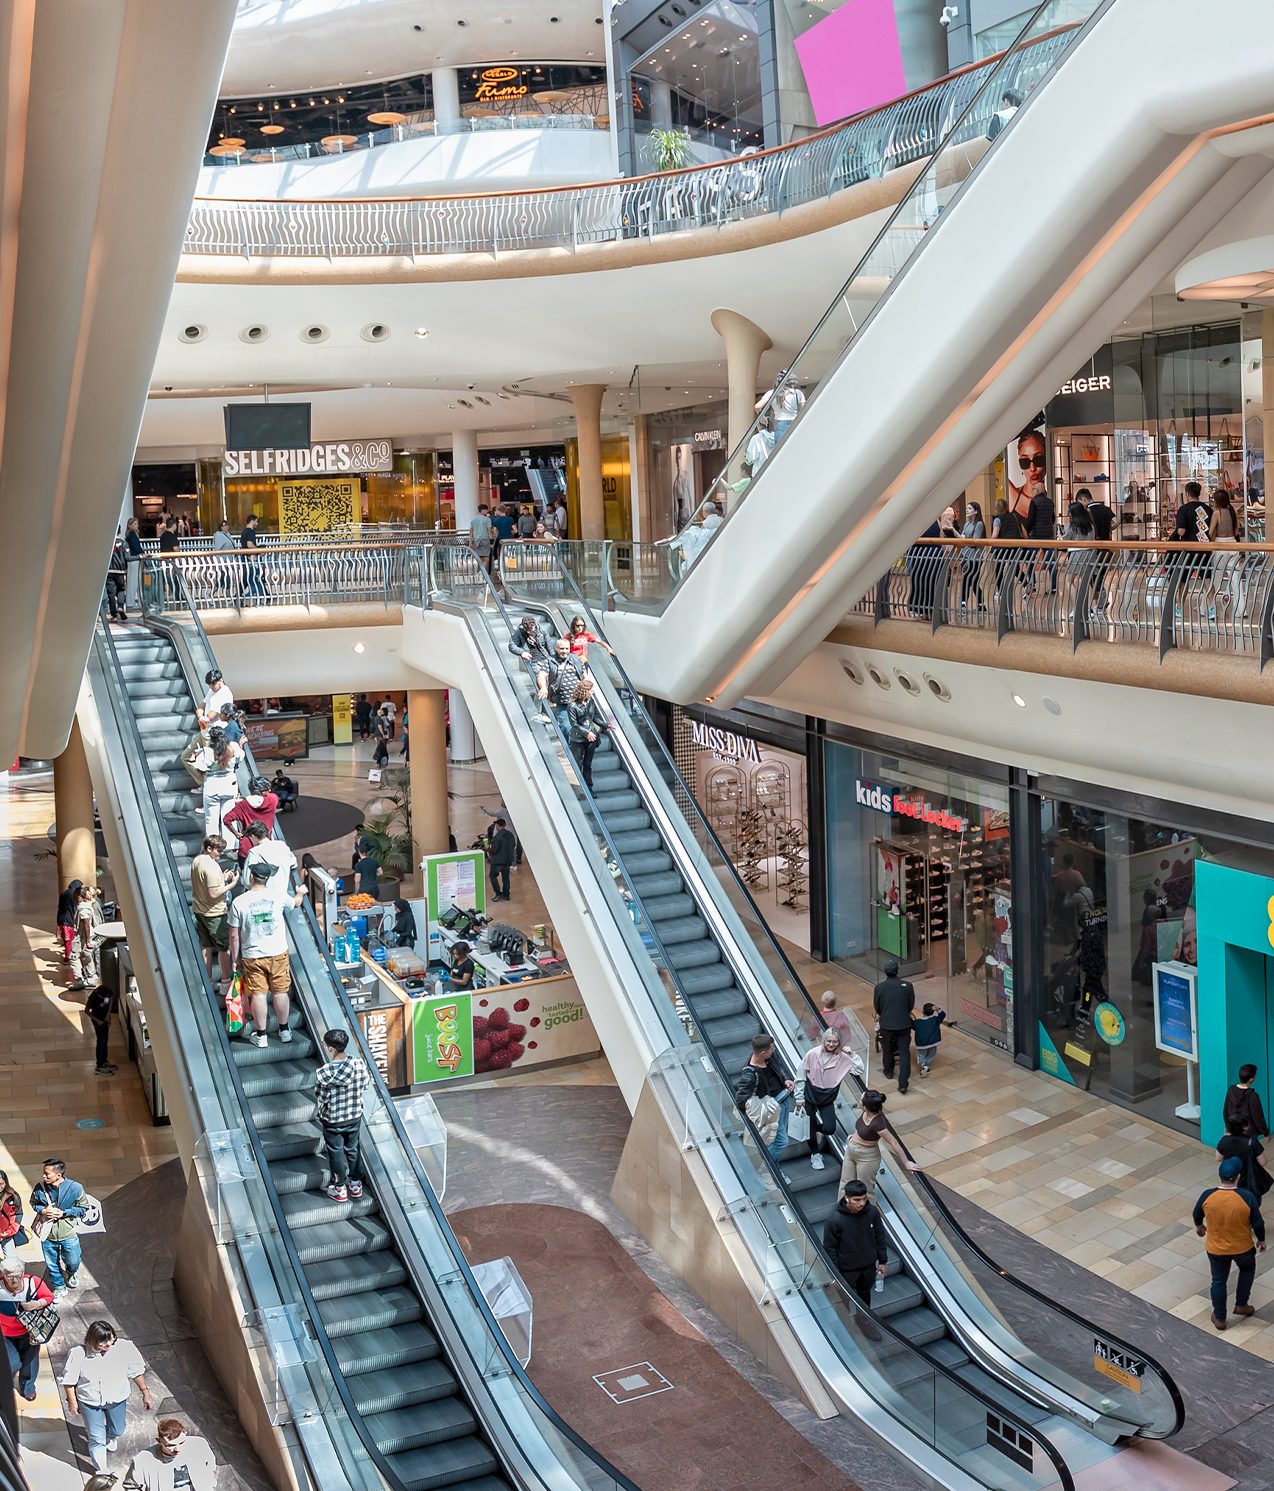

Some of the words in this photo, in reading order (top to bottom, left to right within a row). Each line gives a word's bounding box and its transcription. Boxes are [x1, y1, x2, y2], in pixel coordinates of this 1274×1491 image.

[475, 82, 528, 98] Fumo
[1056, 375, 1111, 395] EIGER
[224, 444, 350, 475] SELFRIDGES
[692, 721, 725, 752] MISS
[726, 731, 759, 764] DIVA
[855, 779, 892, 813] kids
[893, 794, 918, 819] Foot
[921, 803, 963, 833] Locker
[368, 1013, 387, 1026] THE
[542, 1001, 575, 1013] healthy
[544, 1008, 584, 1031] good!
[368, 1024, 388, 1070] SHAKE
[434, 1004, 462, 1073] BOOST
